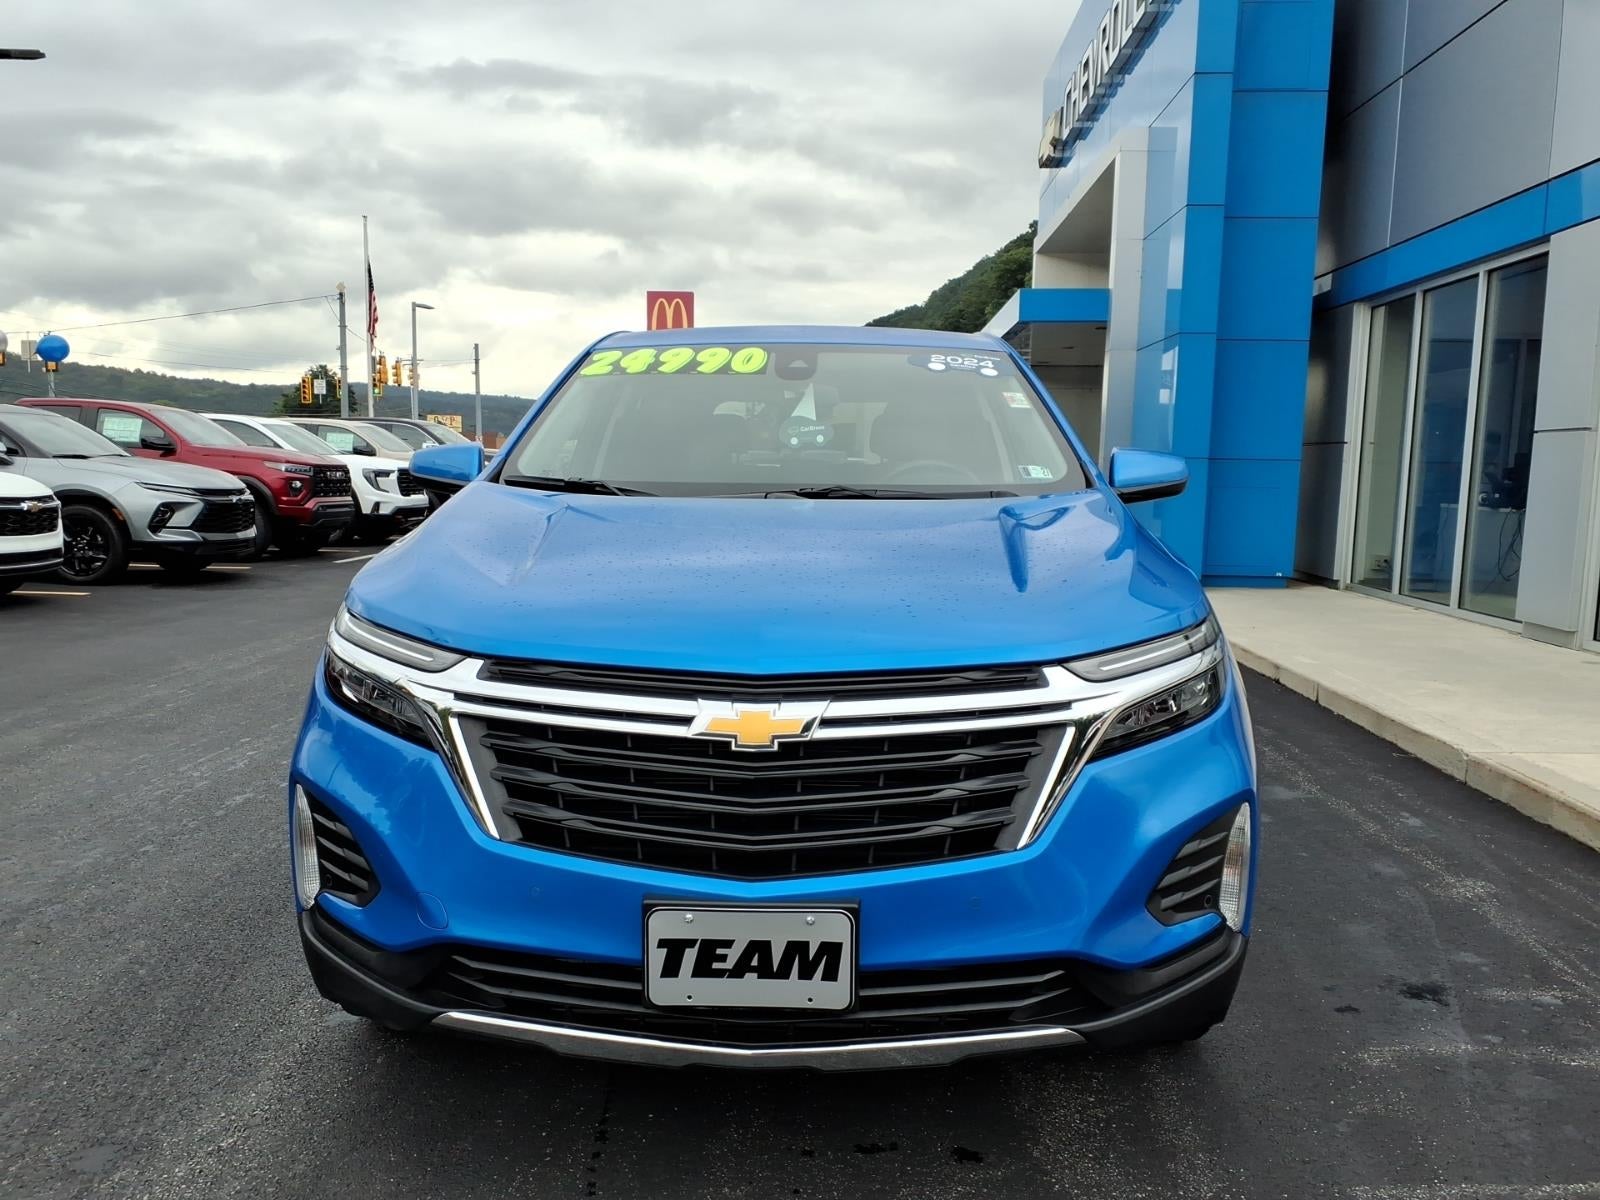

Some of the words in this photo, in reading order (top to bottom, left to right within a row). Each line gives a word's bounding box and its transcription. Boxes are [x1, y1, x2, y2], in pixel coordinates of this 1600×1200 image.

[1063, 0, 1154, 141] CHEVROL
[579, 346, 768, 376] 24990
[930, 354, 995, 369] 2024
[656, 938, 843, 982] TEAM
